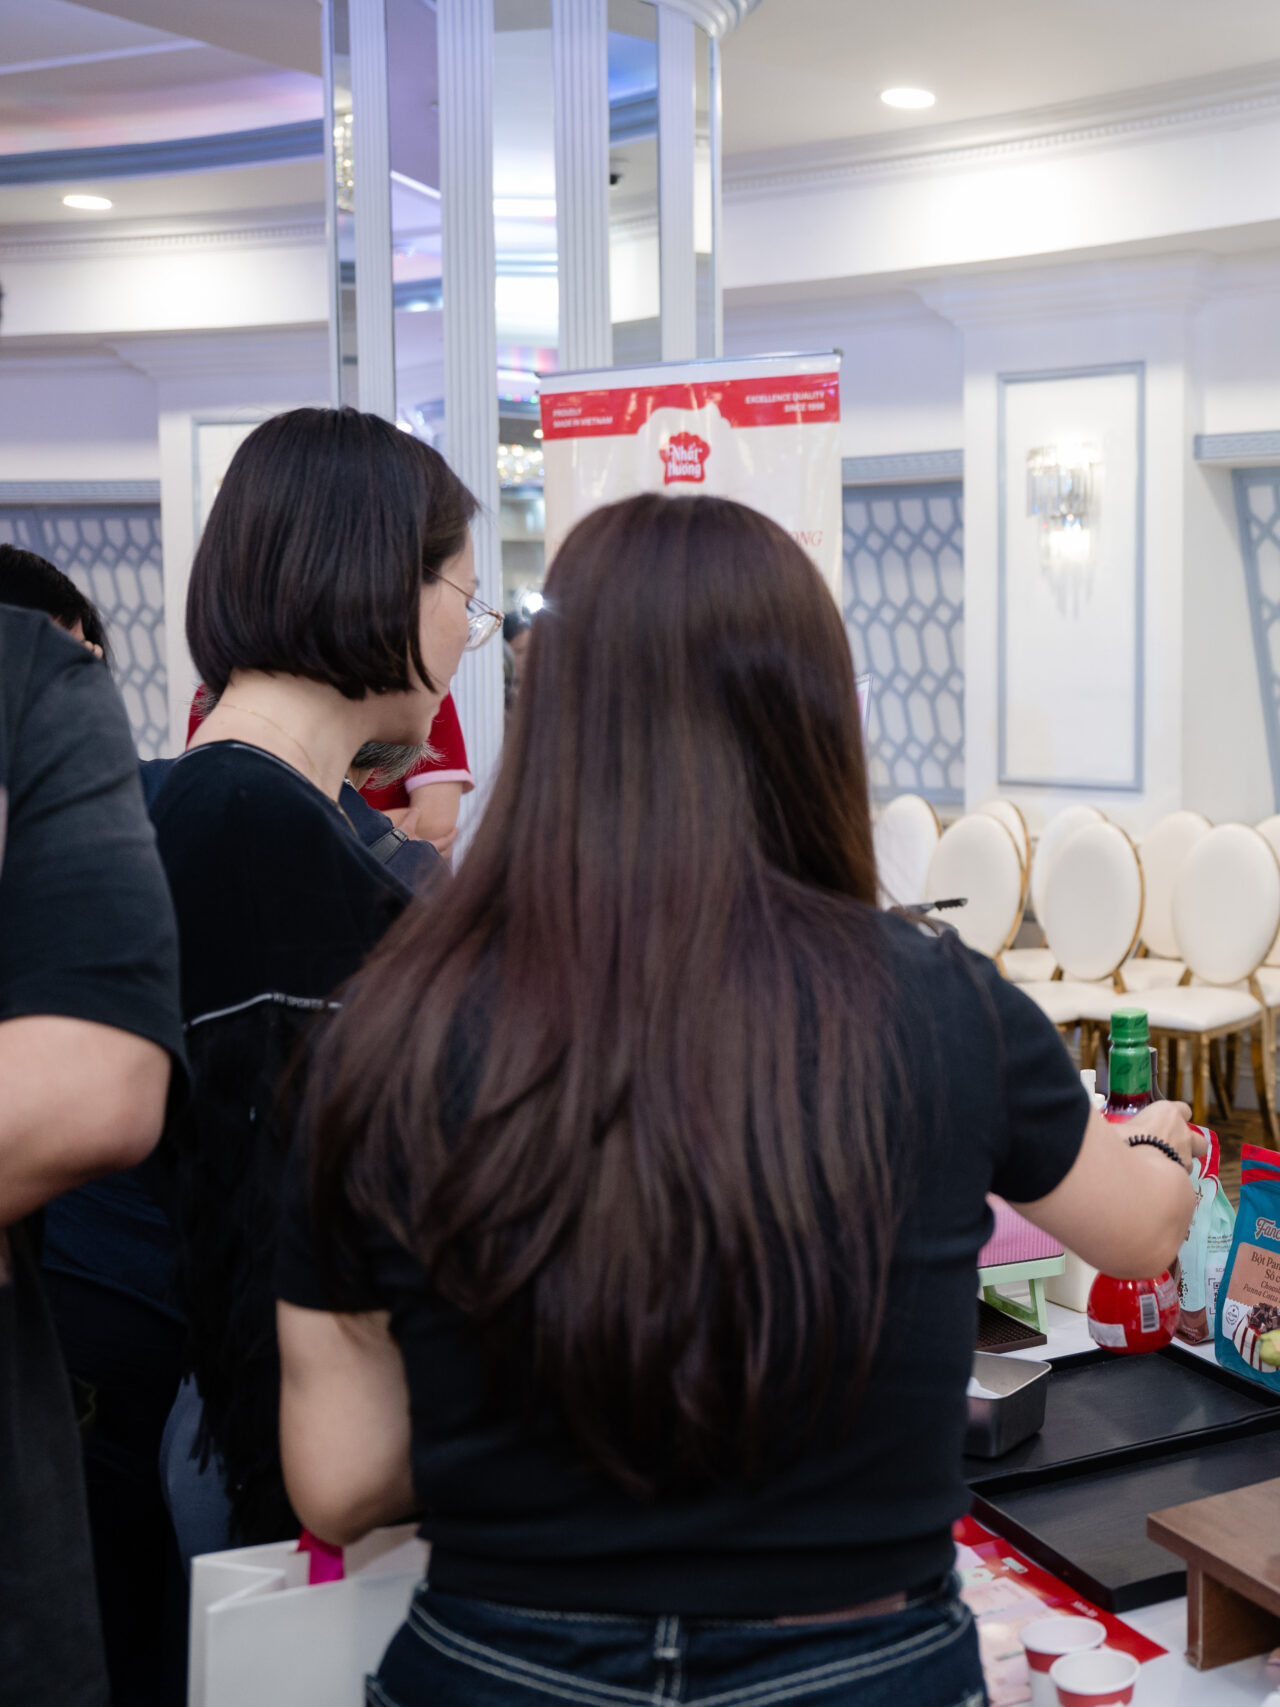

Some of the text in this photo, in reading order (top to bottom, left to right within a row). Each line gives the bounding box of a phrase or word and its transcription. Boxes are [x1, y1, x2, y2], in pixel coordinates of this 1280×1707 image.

[745, 390, 825, 404] EXCELLENCE QUALITY
[1251, 1251, 1265, 1266] Bột
[1243, 1284, 1262, 1297] Panna
[1263, 1290, 1279, 1302] Cotta
